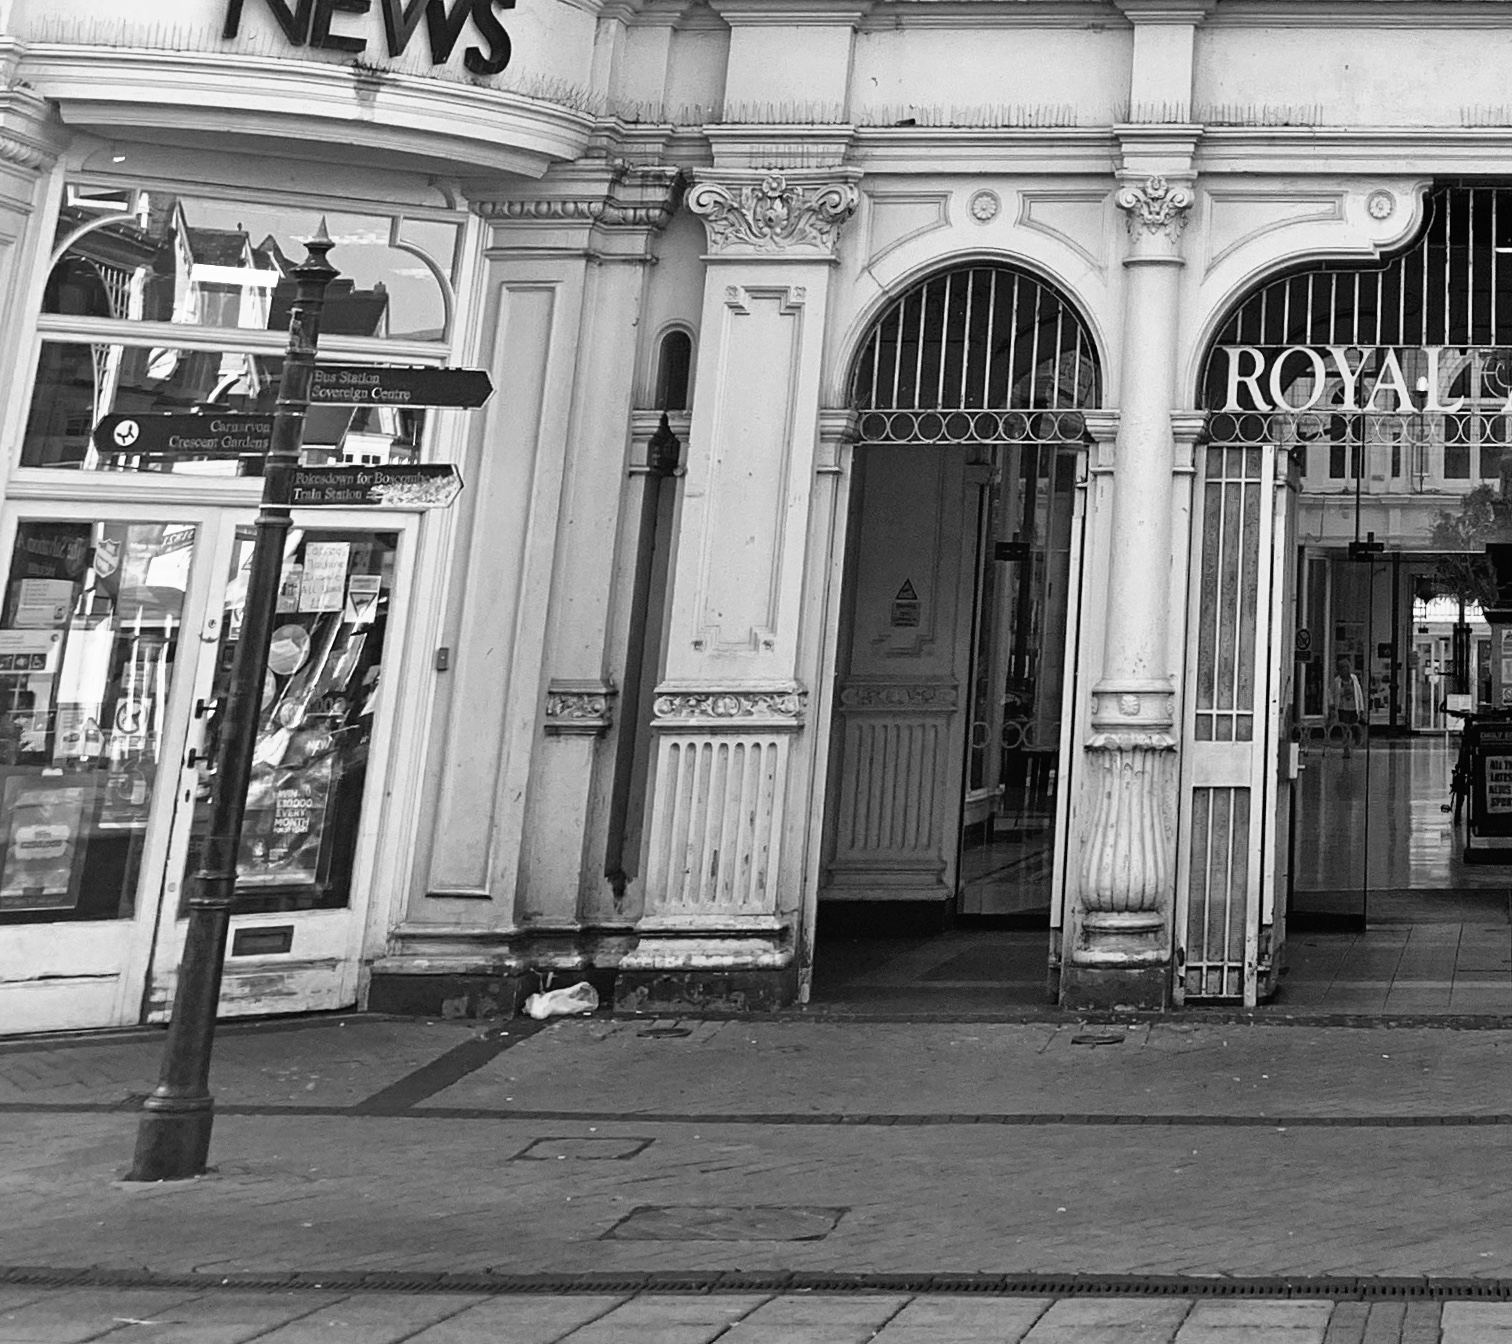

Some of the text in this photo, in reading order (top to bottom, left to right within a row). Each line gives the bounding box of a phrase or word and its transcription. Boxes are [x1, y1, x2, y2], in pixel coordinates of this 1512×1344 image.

[313, 370, 380, 385] Bus Station
[1222, 345, 1465, 413] ROYAL
[311, 386, 412, 401] Sovereign Centre
[210, 420, 271, 434] Carnarvon
[168, 435, 269, 449] Crescent Gardens
[293, 471, 431, 485] Pokesdown for Boscombe
[293, 488, 362, 501] Train Station
[275, 808, 307, 817] EVERY
[274, 817, 310, 827] MONTH
